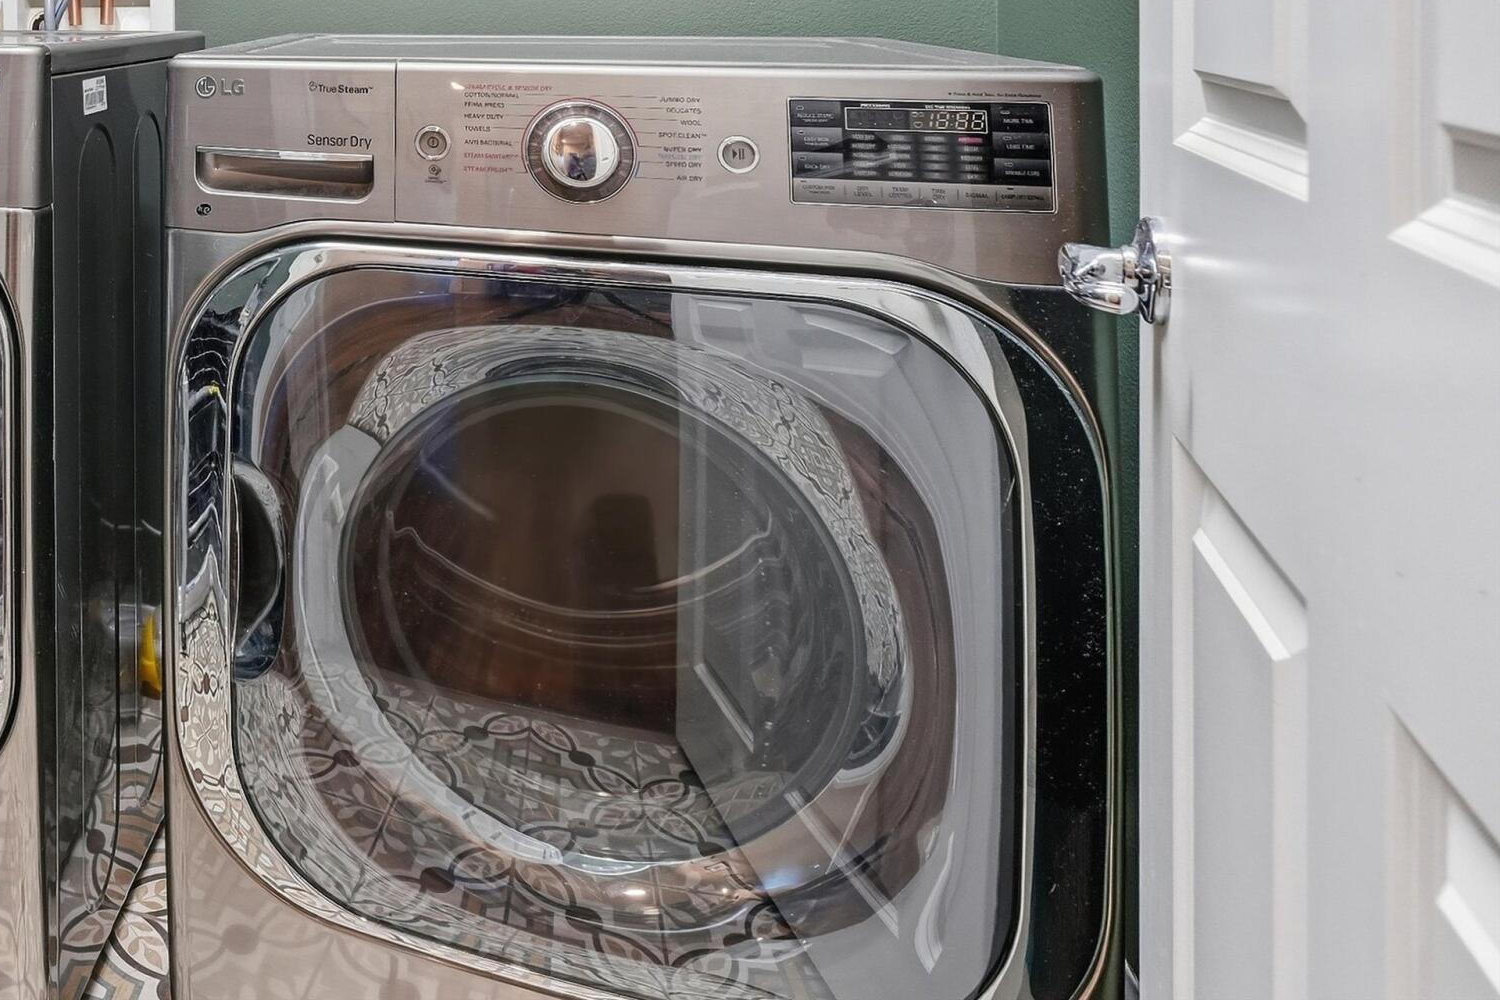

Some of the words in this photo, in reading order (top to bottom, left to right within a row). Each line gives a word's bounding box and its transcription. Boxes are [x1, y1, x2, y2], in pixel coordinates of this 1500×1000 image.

[220, 78, 245, 96] LG
[307, 134, 348, 147] Sensor
[350, 135, 372, 149] Dry
